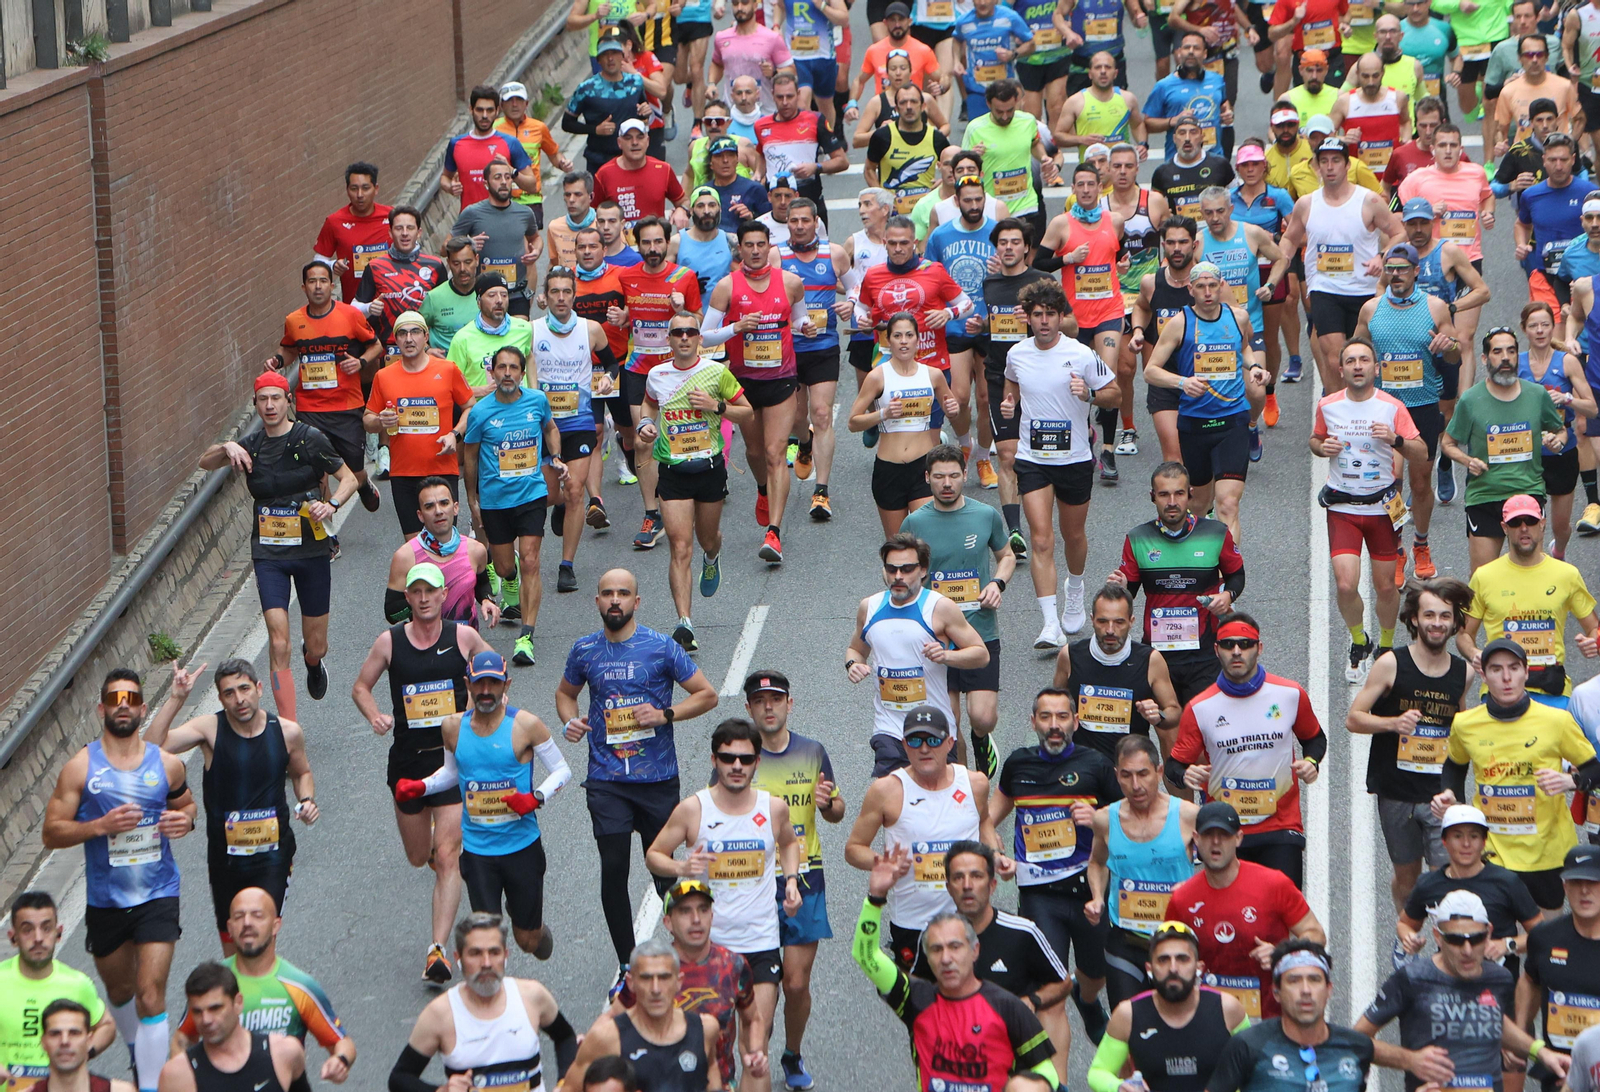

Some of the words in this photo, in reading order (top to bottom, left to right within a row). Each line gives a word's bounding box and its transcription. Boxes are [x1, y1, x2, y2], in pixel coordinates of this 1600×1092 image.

[1004, 168, 1027, 178] ZURICH
[1328, 245, 1349, 253] ZURICH
[1226, 252, 1248, 262] ULSA
[1087, 265, 1110, 273] ZURICH
[576, 299, 618, 309] CUNETAS
[756, 332, 778, 340] ZURICH
[309, 344, 348, 352] CUNETAS
[904, 389, 928, 397] ZURICH
[905, 401, 919, 409] 4444
[679, 424, 704, 433] ZURICH
[1042, 421, 1066, 429] ZURICH
[1503, 423, 1527, 432] ZURICH
[512, 439, 534, 448] ZURICH
[947, 571, 973, 579] ZURICH
[948, 585, 963, 593] 3999
[1522, 622, 1550, 630] ZURICH
[604, 671, 627, 681] MÁLAGA
[890, 670, 918, 678] ZURICH
[419, 682, 447, 692] ZURICH
[1098, 689, 1127, 698] ZURICH
[421, 698, 438, 706] 4542
[616, 696, 644, 707] ZURICH
[1096, 703, 1114, 711] 4738
[1083, 714, 1100, 722] ANDRE
[1102, 715, 1126, 723] CESTER
[1419, 728, 1447, 736] ZURICH
[1217, 738, 1238, 749] CLUB
[1241, 731, 1283, 744] TRIATLÓN
[1226, 741, 1274, 754] ALGECIRAS
[481, 781, 510, 790] ZURICH
[1240, 780, 1270, 789] ZURICH
[1497, 787, 1529, 796] ZURICH
[483, 796, 500, 804] 5804
[783, 793, 812, 806] ARIA
[1239, 796, 1258, 804] 4252
[1497, 803, 1516, 812] 5462
[243, 810, 270, 820] ZURICH
[1036, 811, 1065, 822] ZURICH
[1039, 829, 1056, 838] 5121
[727, 841, 759, 850] ZURICH
[932, 843, 951, 851] ZURI
[727, 858, 746, 867] 5690
[715, 871, 735, 879] PABLO
[736, 869, 759, 878] ATOCHE
[922, 872, 940, 881] PACO
[1138, 882, 1171, 892] ZURICH
[1137, 900, 1157, 908] 4538
[1133, 912, 1161, 920] MANOLO
[1220, 978, 1253, 987] ZURICH
[1570, 999, 1600, 1008] ZURICH
[1430, 1003, 1501, 1022] SWISS
[1431, 1023, 1503, 1040] PEAKS
[490, 1073, 523, 1085] ZURICH
[1452, 1076, 1487, 1087] ZURICH
